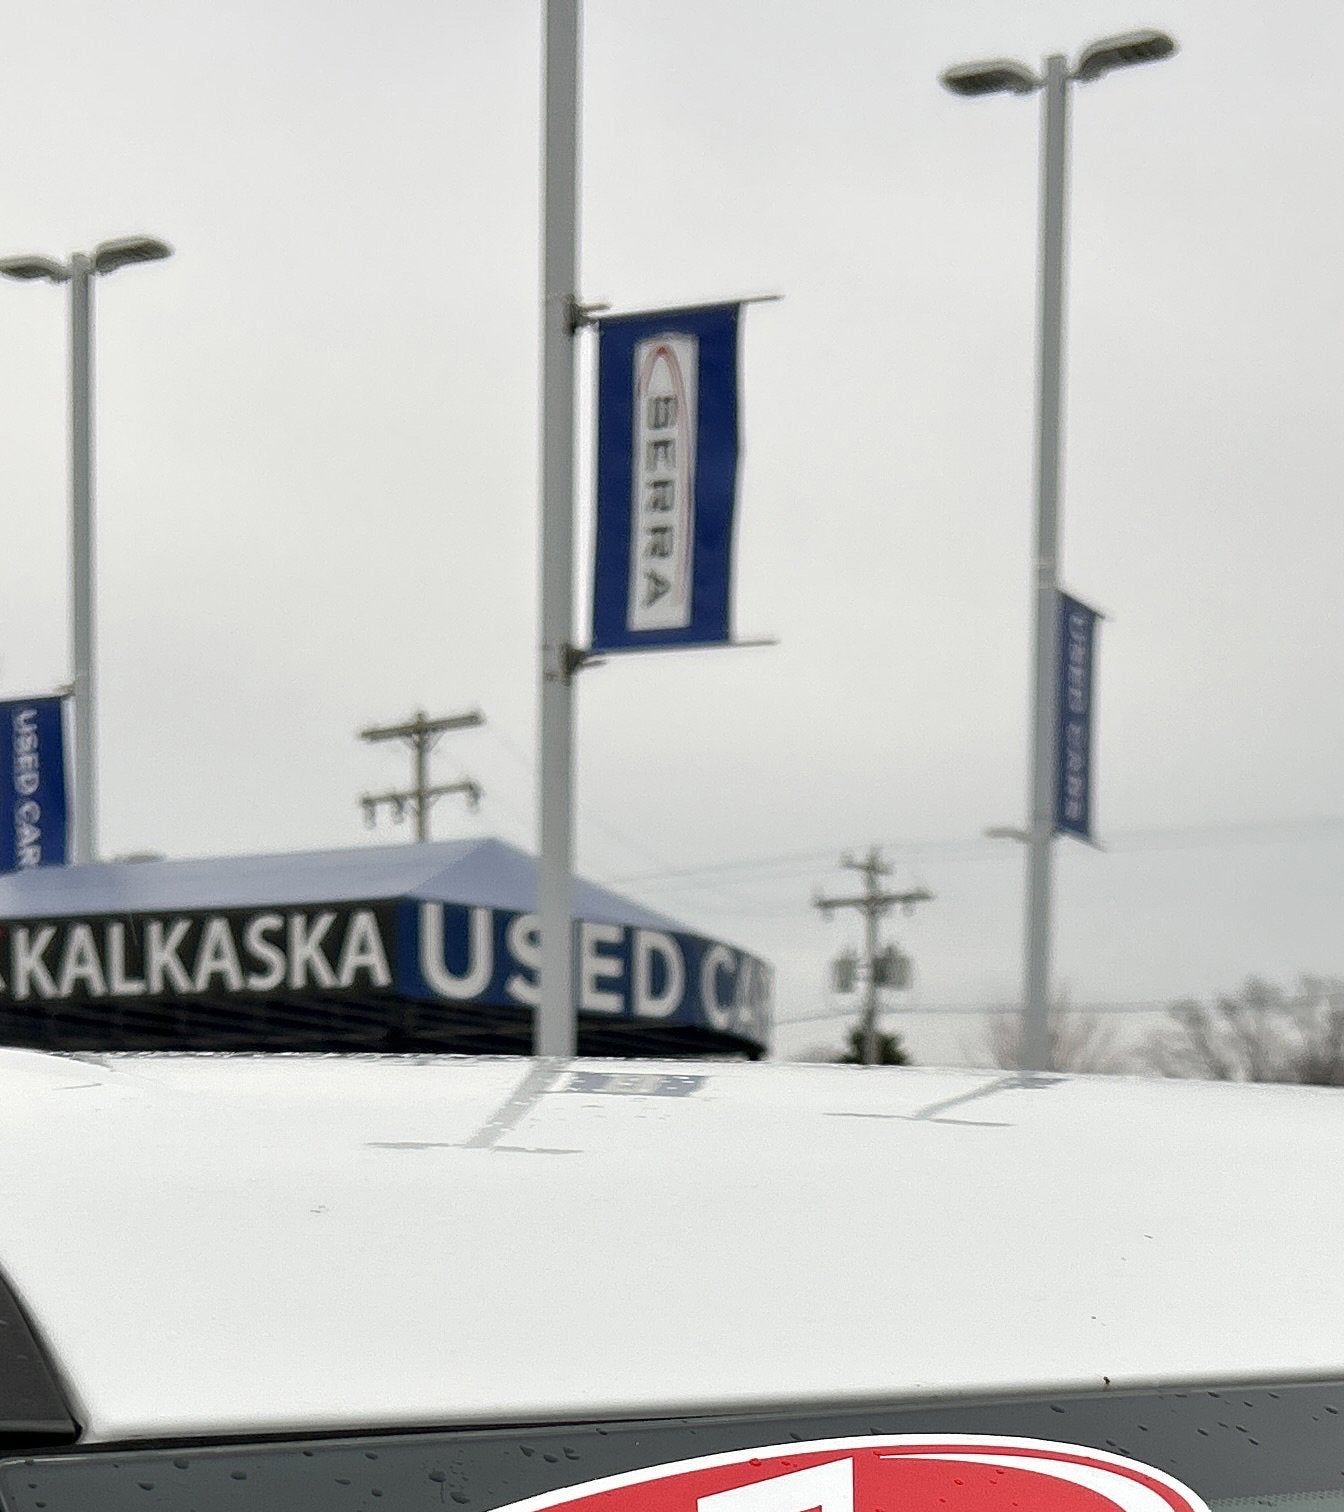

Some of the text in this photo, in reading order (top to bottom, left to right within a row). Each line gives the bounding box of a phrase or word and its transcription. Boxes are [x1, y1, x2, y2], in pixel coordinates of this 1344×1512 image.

[644, 395, 675, 608] SERRA
[14, 708, 40, 796] USED
[11, 908, 393, 1000] KALKASKA
